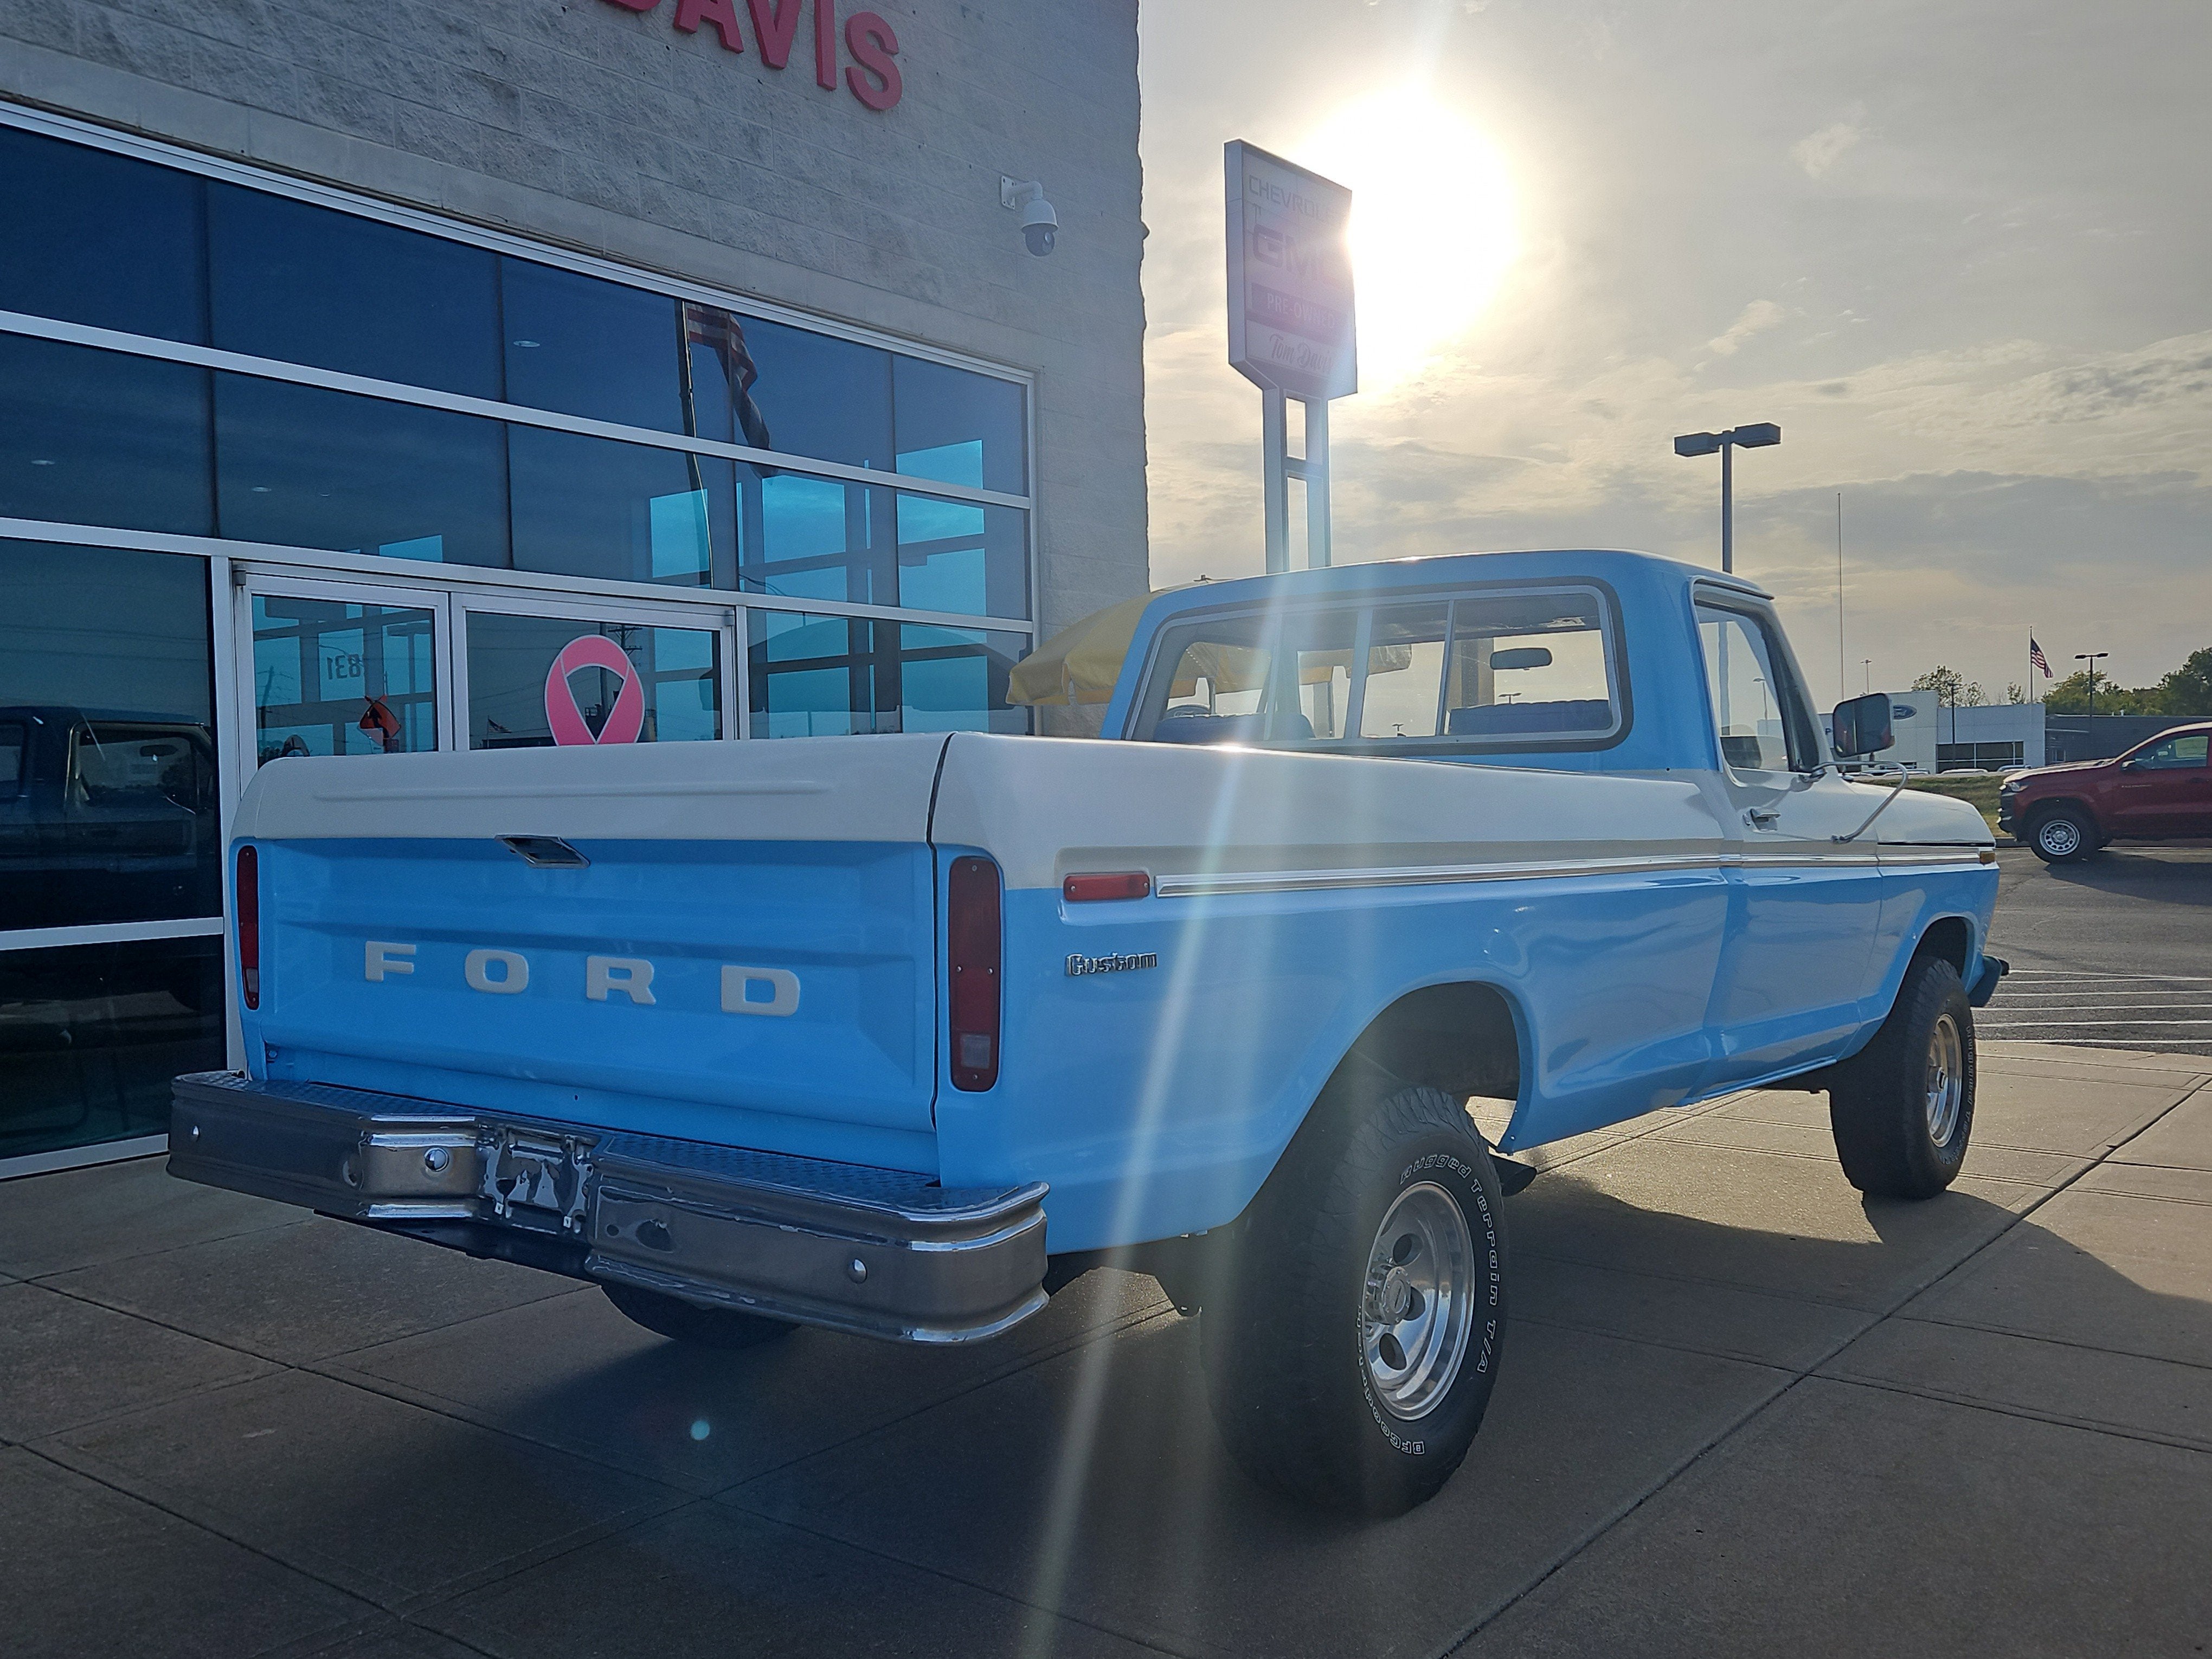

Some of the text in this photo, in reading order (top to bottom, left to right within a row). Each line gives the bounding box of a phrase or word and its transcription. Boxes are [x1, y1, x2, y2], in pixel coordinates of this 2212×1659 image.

[604, 0, 902, 110] AVIS
[1249, 175, 1345, 228] CHEVROLE
[365, 941, 800, 1017] FORD
[1065, 952, 1158, 976] Custom
[1400, 1155, 1500, 1373] Rugged Terrain T/A
